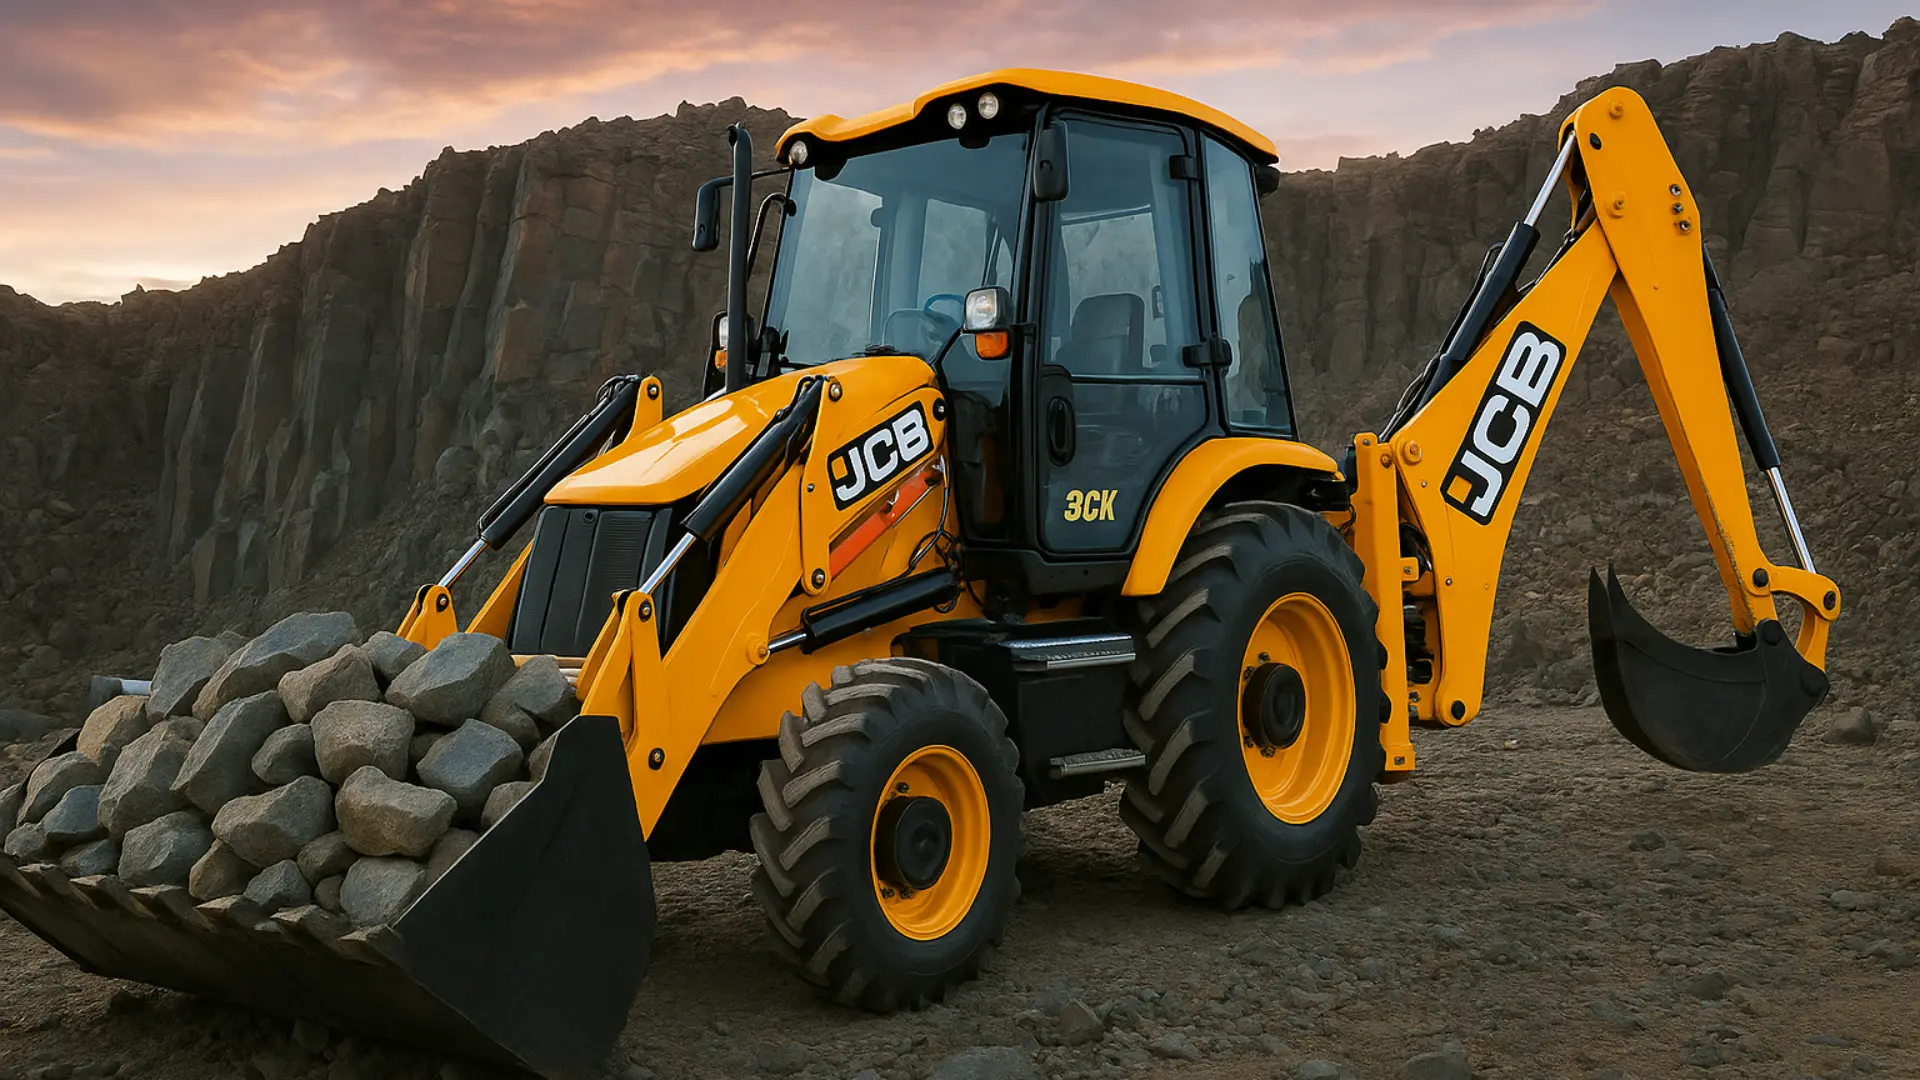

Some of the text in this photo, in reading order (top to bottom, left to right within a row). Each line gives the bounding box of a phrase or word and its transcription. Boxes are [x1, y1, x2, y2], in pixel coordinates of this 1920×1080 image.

[835, 409, 930, 502] JCB
[1460, 331, 1561, 518] JCB
[1063, 489, 1119, 522] 3CK
